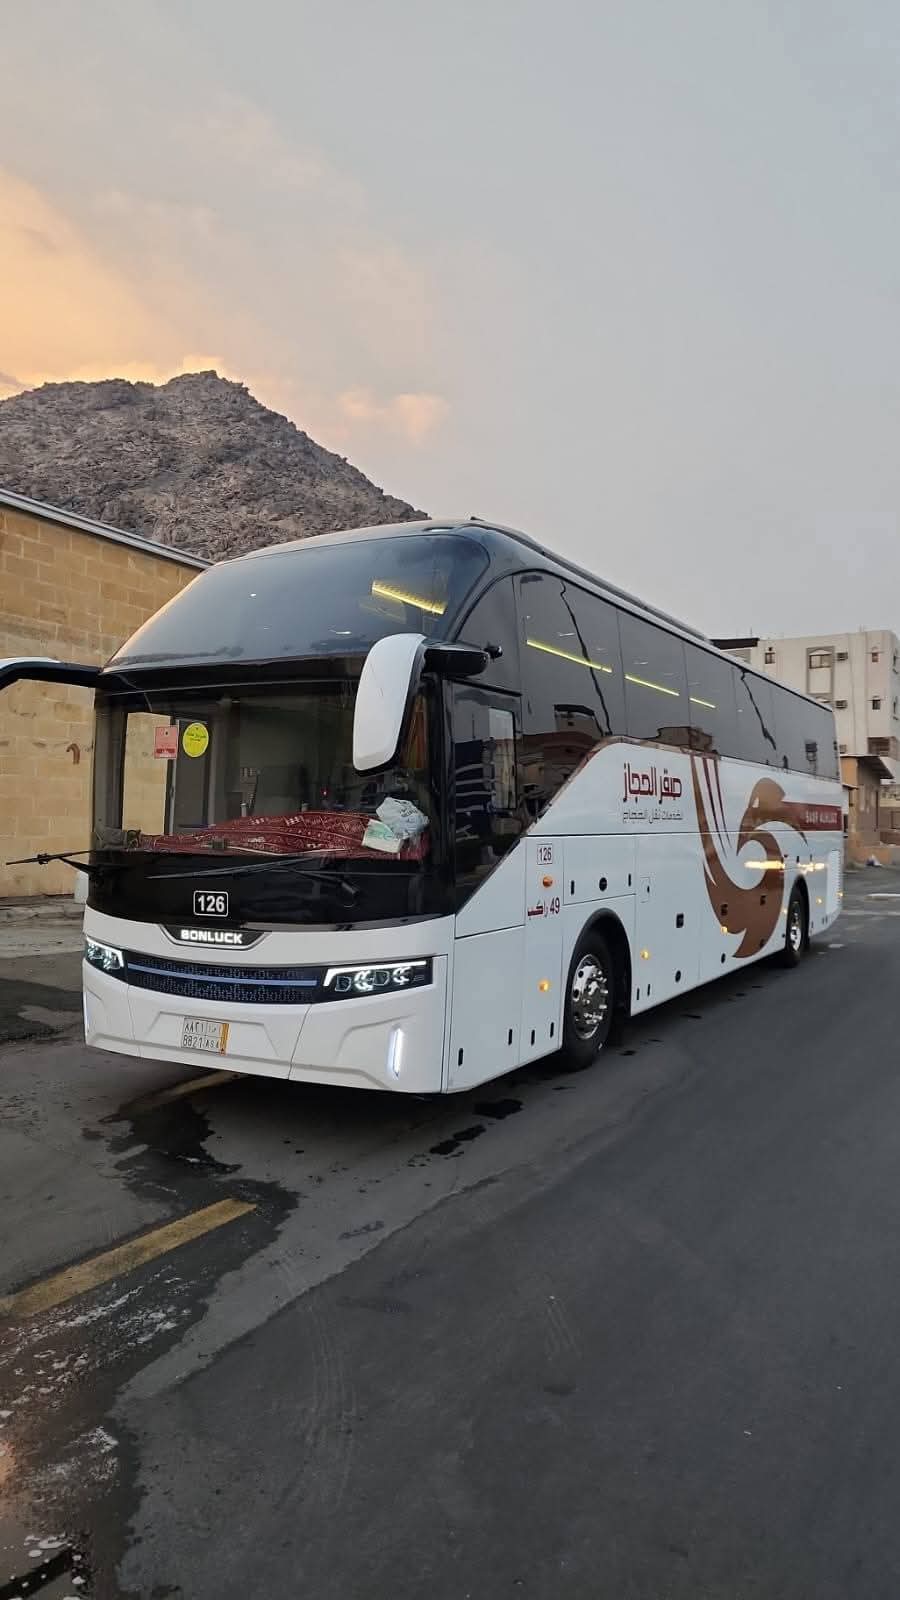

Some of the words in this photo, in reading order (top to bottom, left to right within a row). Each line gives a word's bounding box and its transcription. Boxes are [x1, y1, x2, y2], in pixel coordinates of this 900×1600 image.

[623, 762, 657, 804] الحجاز
[659, 768, 682, 804] صقر
[539, 847, 552, 861] 126
[198, 895, 225, 913] 126
[528, 900, 549, 921] راكب
[550, 897, 560, 915] 49
[181, 929, 243, 944] BONLUCK
